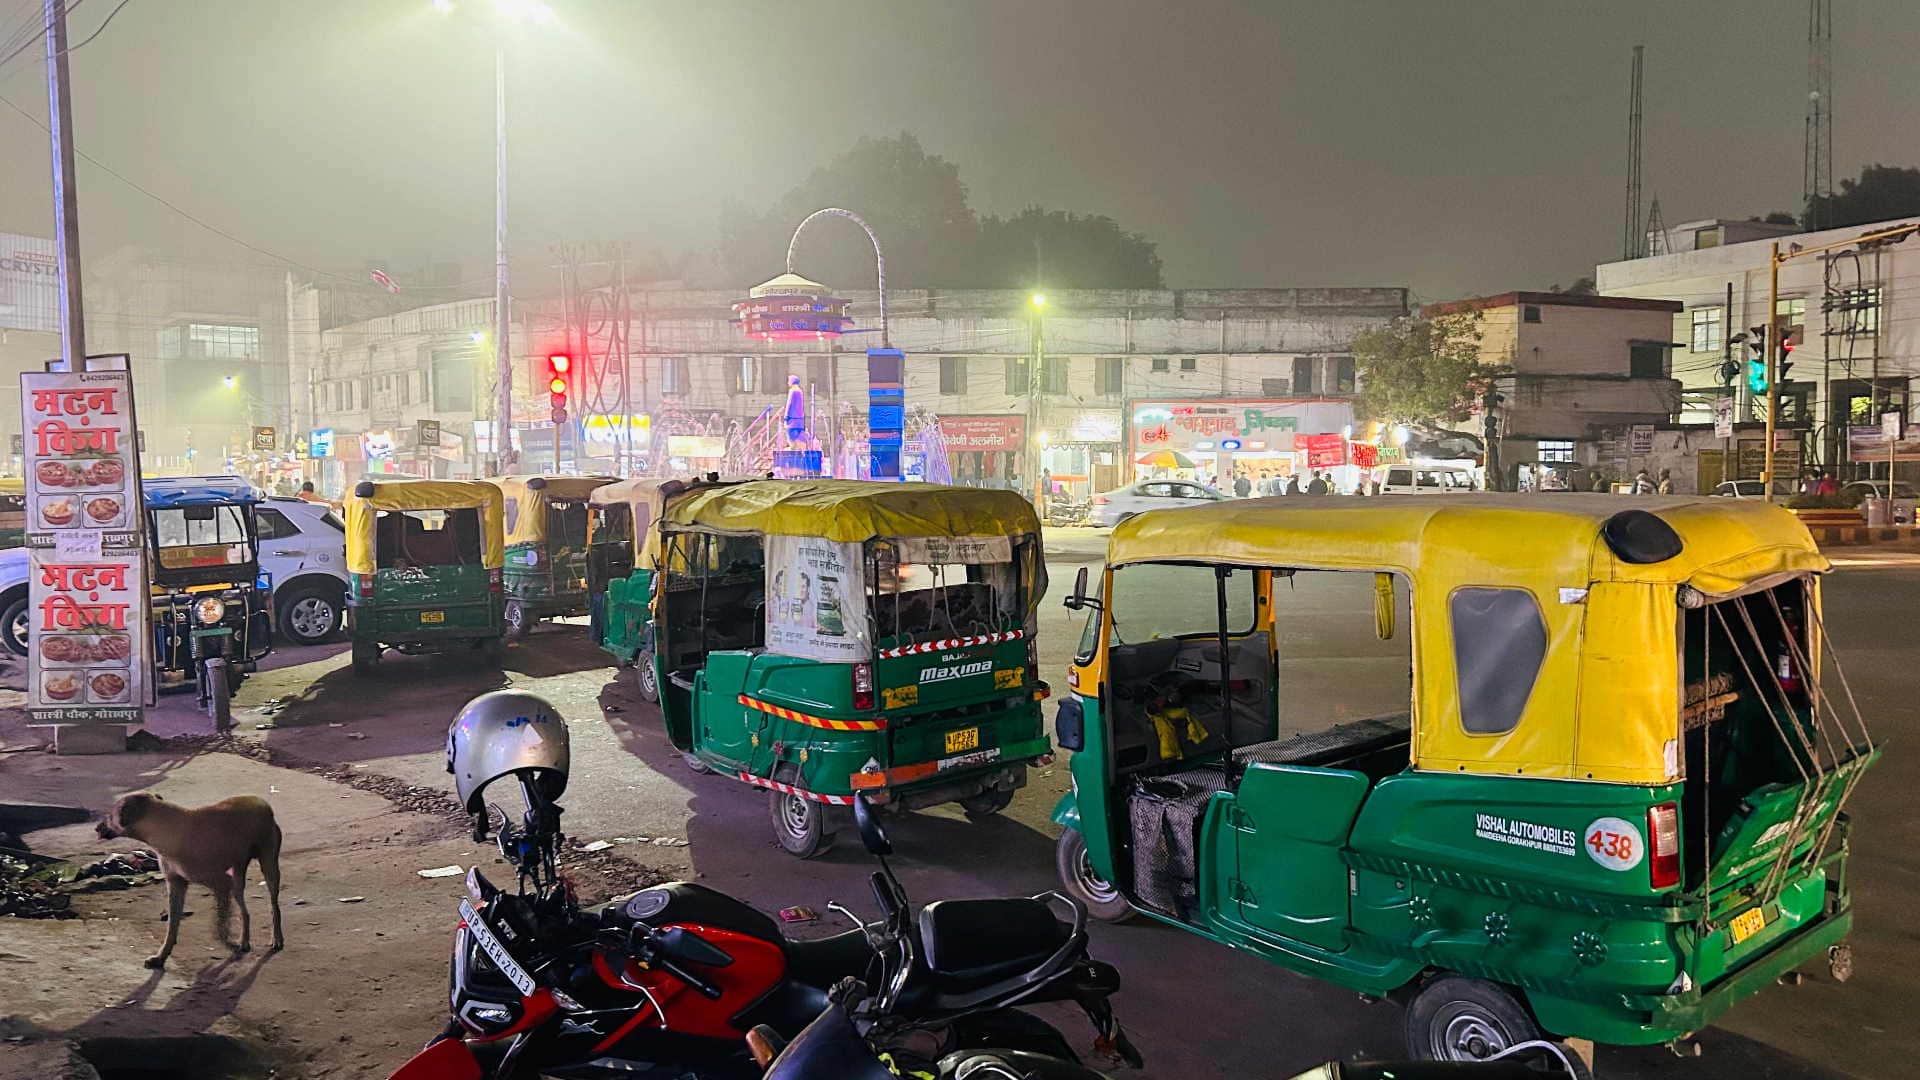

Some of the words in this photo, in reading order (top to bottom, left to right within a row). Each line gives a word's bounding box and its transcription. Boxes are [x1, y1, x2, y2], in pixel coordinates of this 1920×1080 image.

[32, 388, 118, 416] मटन
[32, 416, 120, 456] किंग
[40, 564, 129, 591] मटन
[38, 592, 130, 631] किंग
[1476, 813, 1508, 834] VISHAL
[1509, 820, 1576, 847] AUTOMOBILES
[1507, 835, 1543, 850] GORAKHPUR
[1587, 830, 1633, 860] 438
